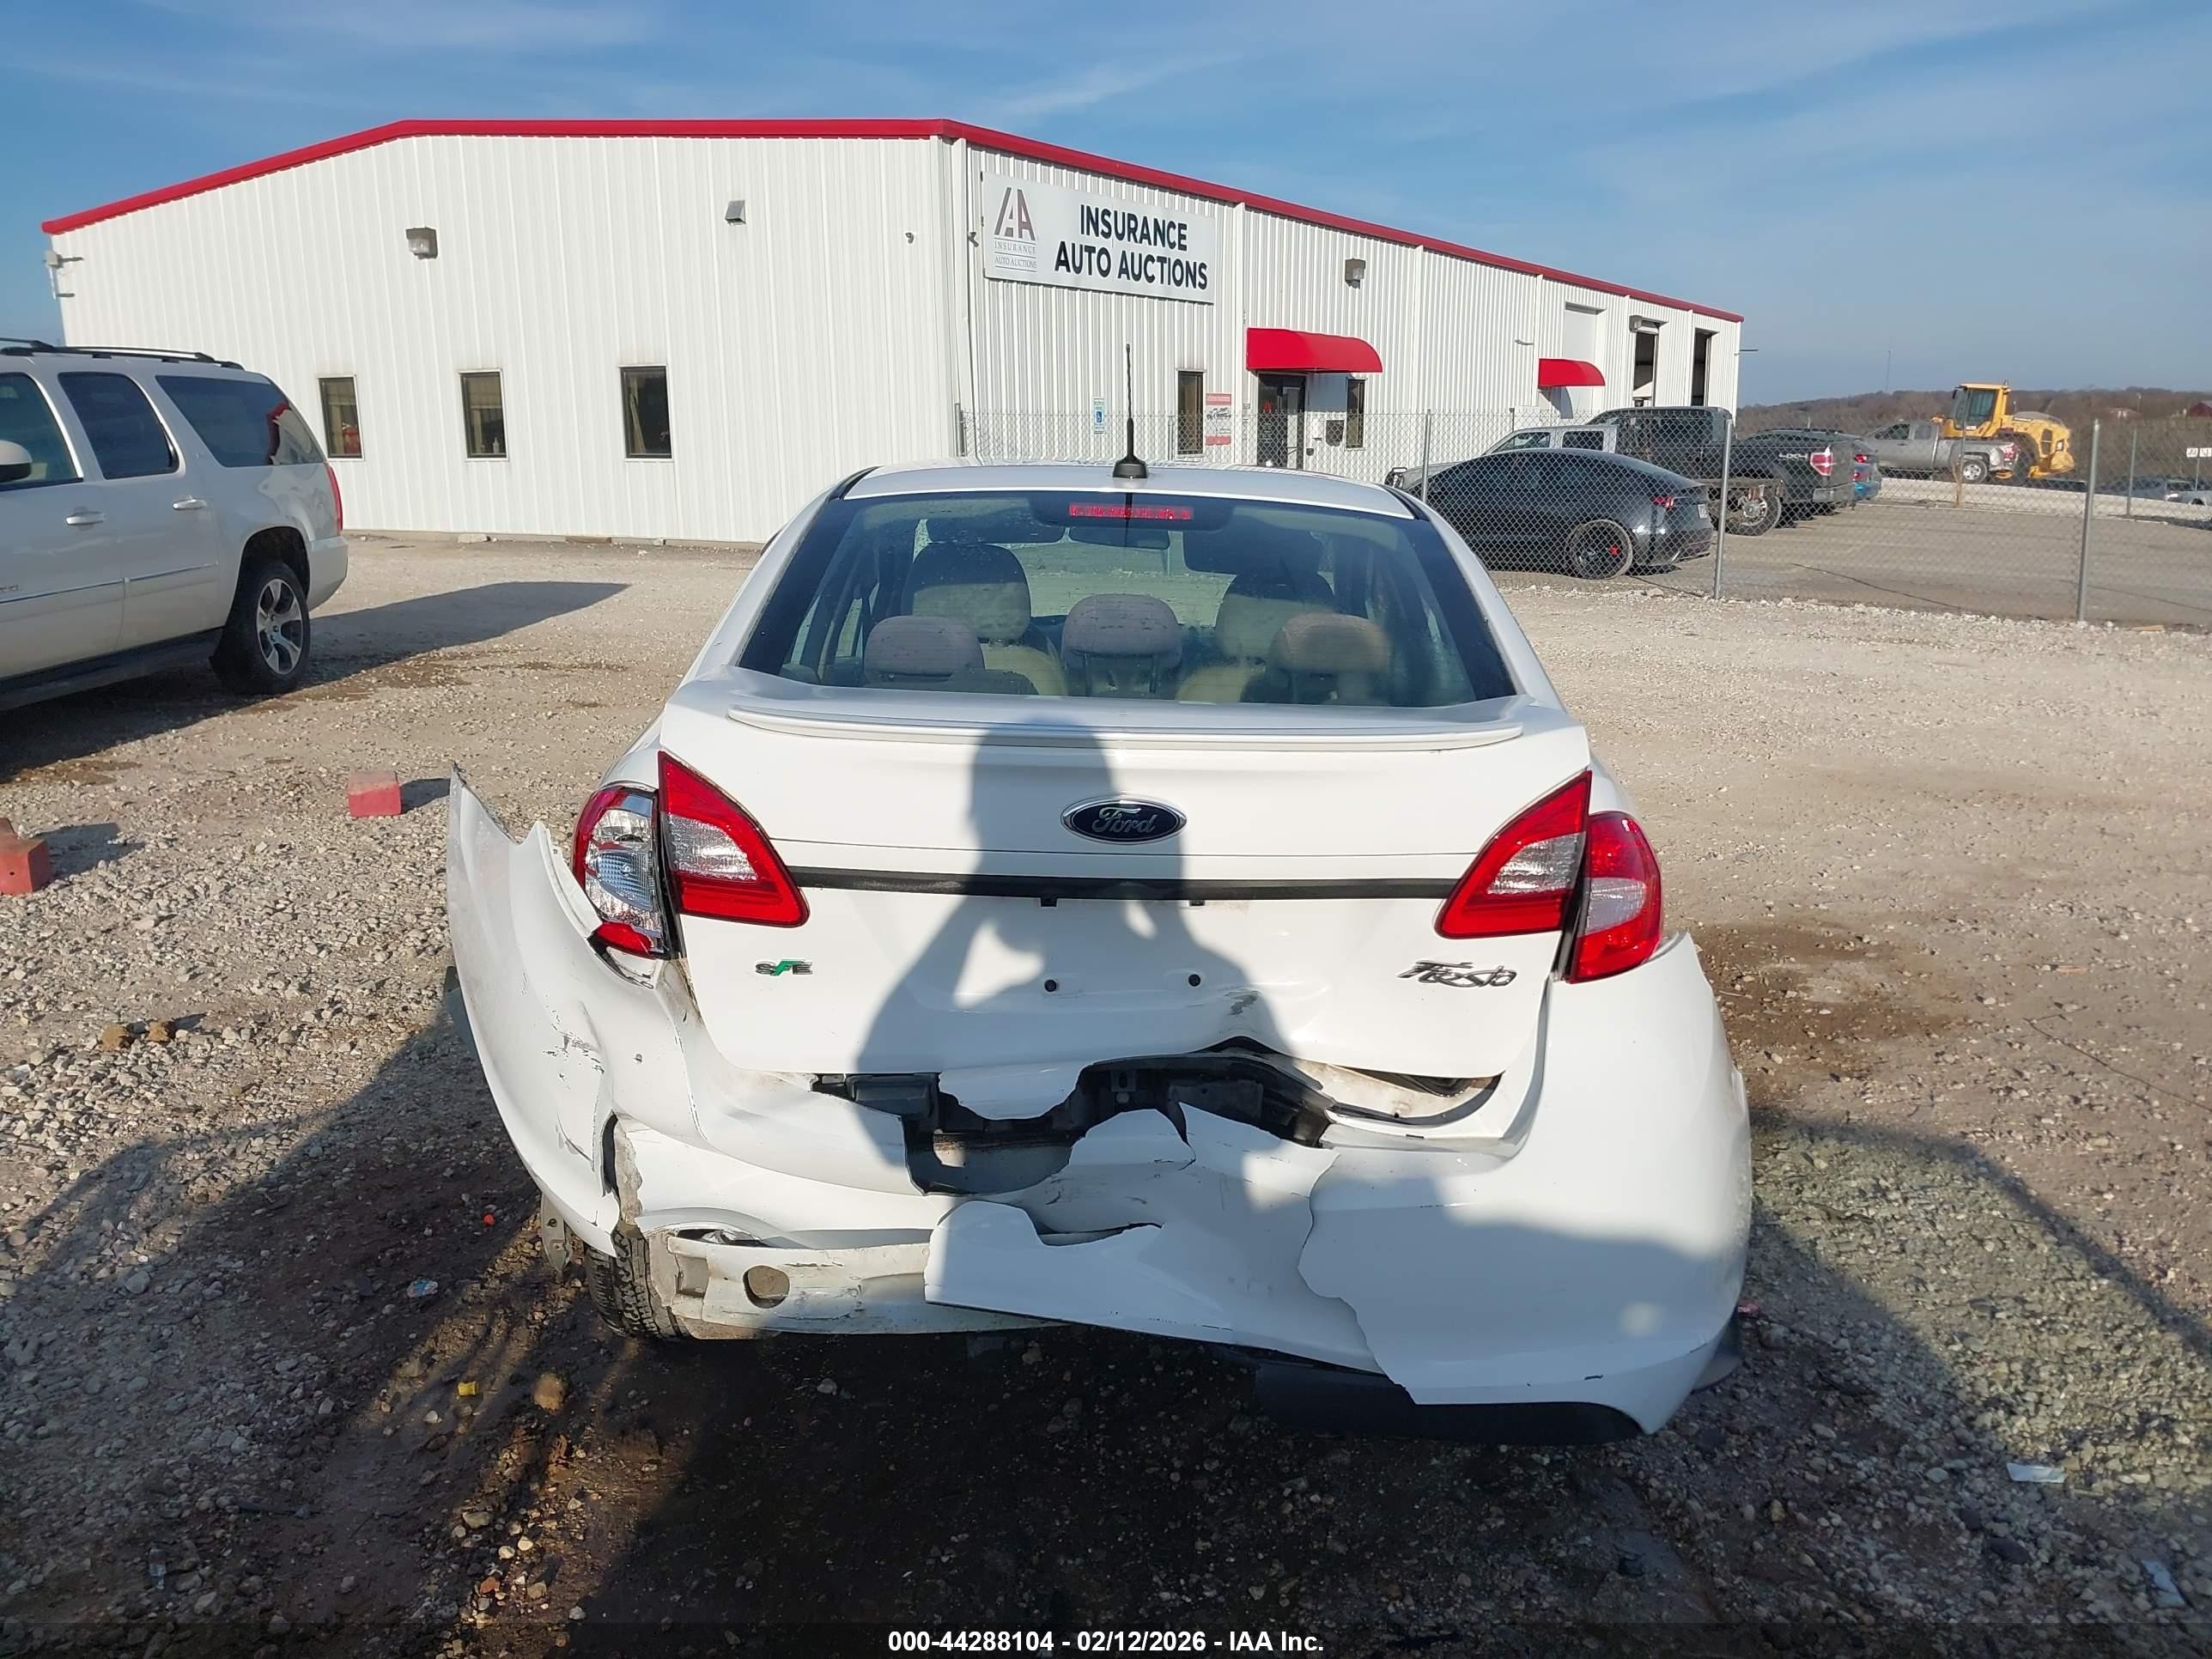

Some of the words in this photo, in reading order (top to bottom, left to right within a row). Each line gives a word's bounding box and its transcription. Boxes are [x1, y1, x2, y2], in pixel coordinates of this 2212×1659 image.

[1079, 204, 1188, 252] INSURANCE
[994, 240, 1036, 255] INSURANCE
[995, 256, 1010, 266] AUTO
[1009, 258, 1037, 270] AUCTIONS
[1054, 240, 1111, 278] AUTO
[1117, 250, 1208, 290] AUCTIONS
[1091, 806, 1158, 834] Ford
[1395, 961, 1517, 988] Fiesta
